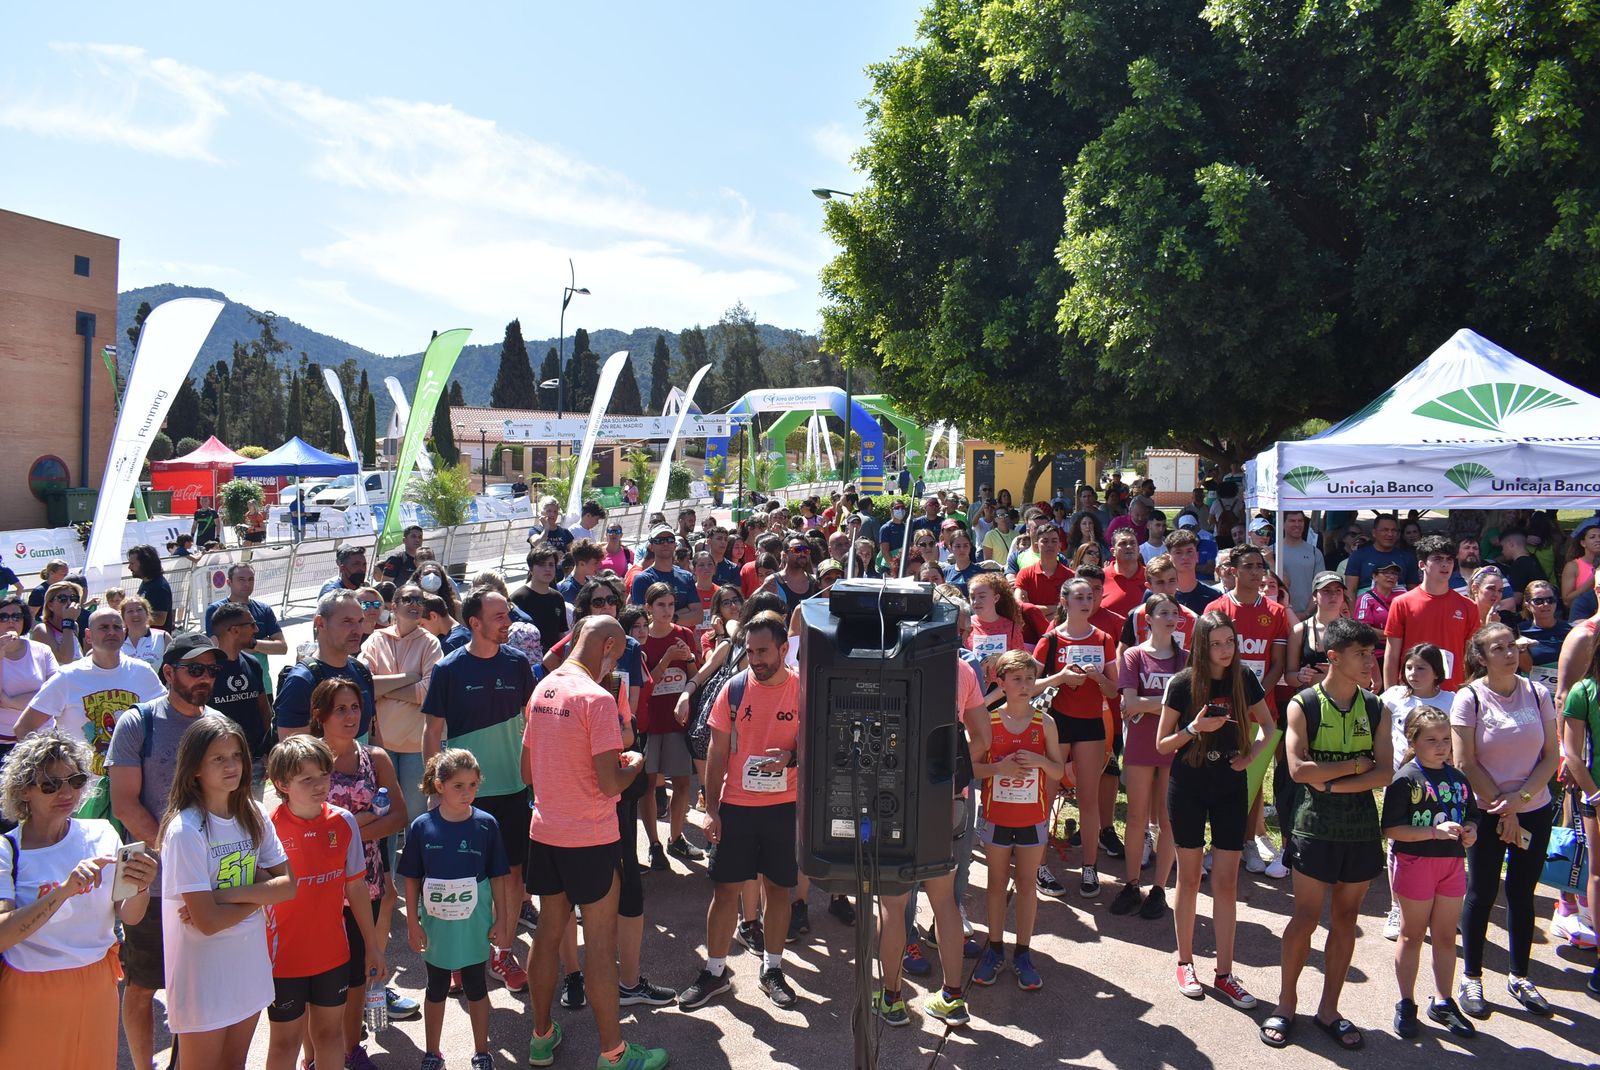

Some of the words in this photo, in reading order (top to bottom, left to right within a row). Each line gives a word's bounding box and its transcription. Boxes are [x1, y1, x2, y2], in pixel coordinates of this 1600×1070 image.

[138, 389, 168, 438] Running
[1327, 480, 1384, 496] Unicaja
[1387, 481, 1433, 493] Banco
[1491, 477, 1551, 494] Unicaja
[1554, 480, 1600, 492] Banco
[30, 545, 65, 558] Guzmán
[975, 642, 1003, 651] 494
[1072, 655, 1101, 663] 565
[1540, 674, 1558, 683] 76
[214, 690, 258, 704] BALENCIAG
[553, 707, 570, 717] CLUB
[776, 711, 794, 721] GO
[999, 778, 1035, 789] 697
[217, 850, 256, 890] 51
[1569, 864, 1580, 888] Jom
[429, 890, 473, 904] 846
